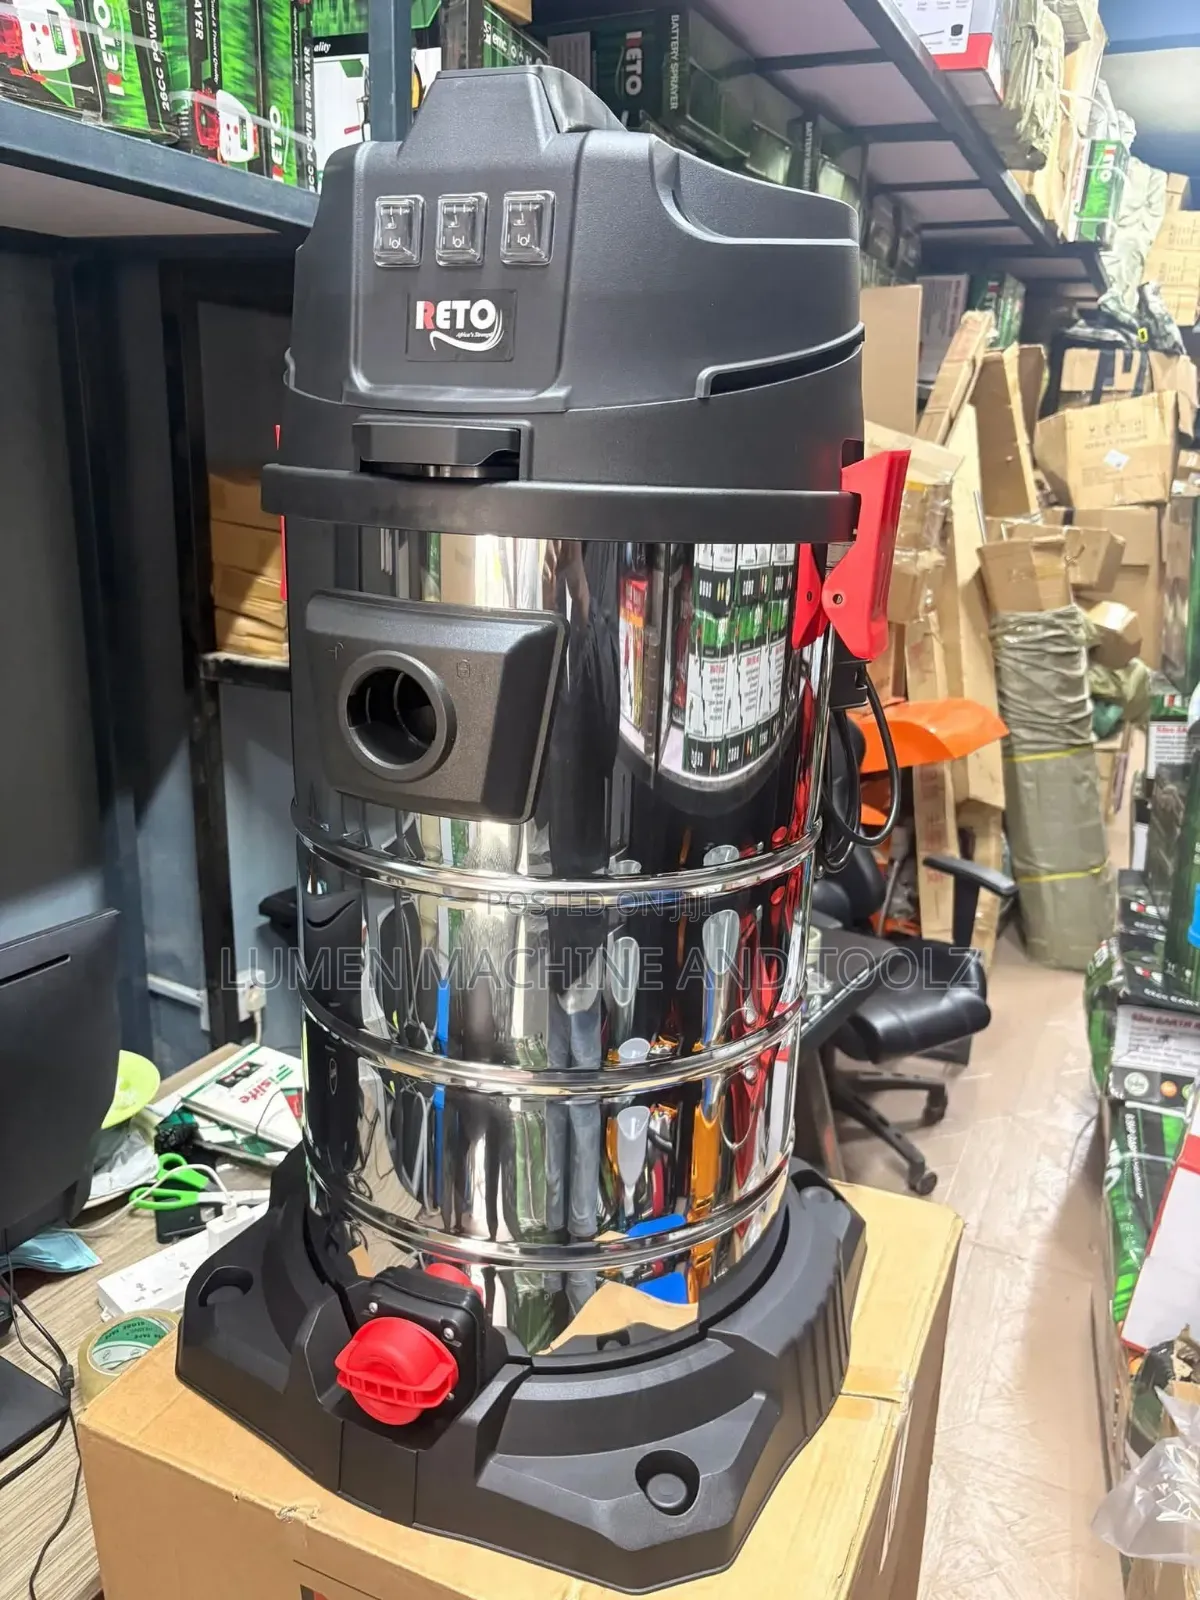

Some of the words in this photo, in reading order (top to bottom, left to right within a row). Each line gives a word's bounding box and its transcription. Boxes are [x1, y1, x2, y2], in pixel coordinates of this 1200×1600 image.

[146, 1, 163, 63] POWER
[669, 14, 680, 61] BATTERY
[303, 46, 312, 109] SPRAYER
[625, 31, 642, 96] RETO
[669, 62, 680, 110] SPRAYER
[305, 113, 314, 162] POWER
[415, 299, 496, 330] RETO
